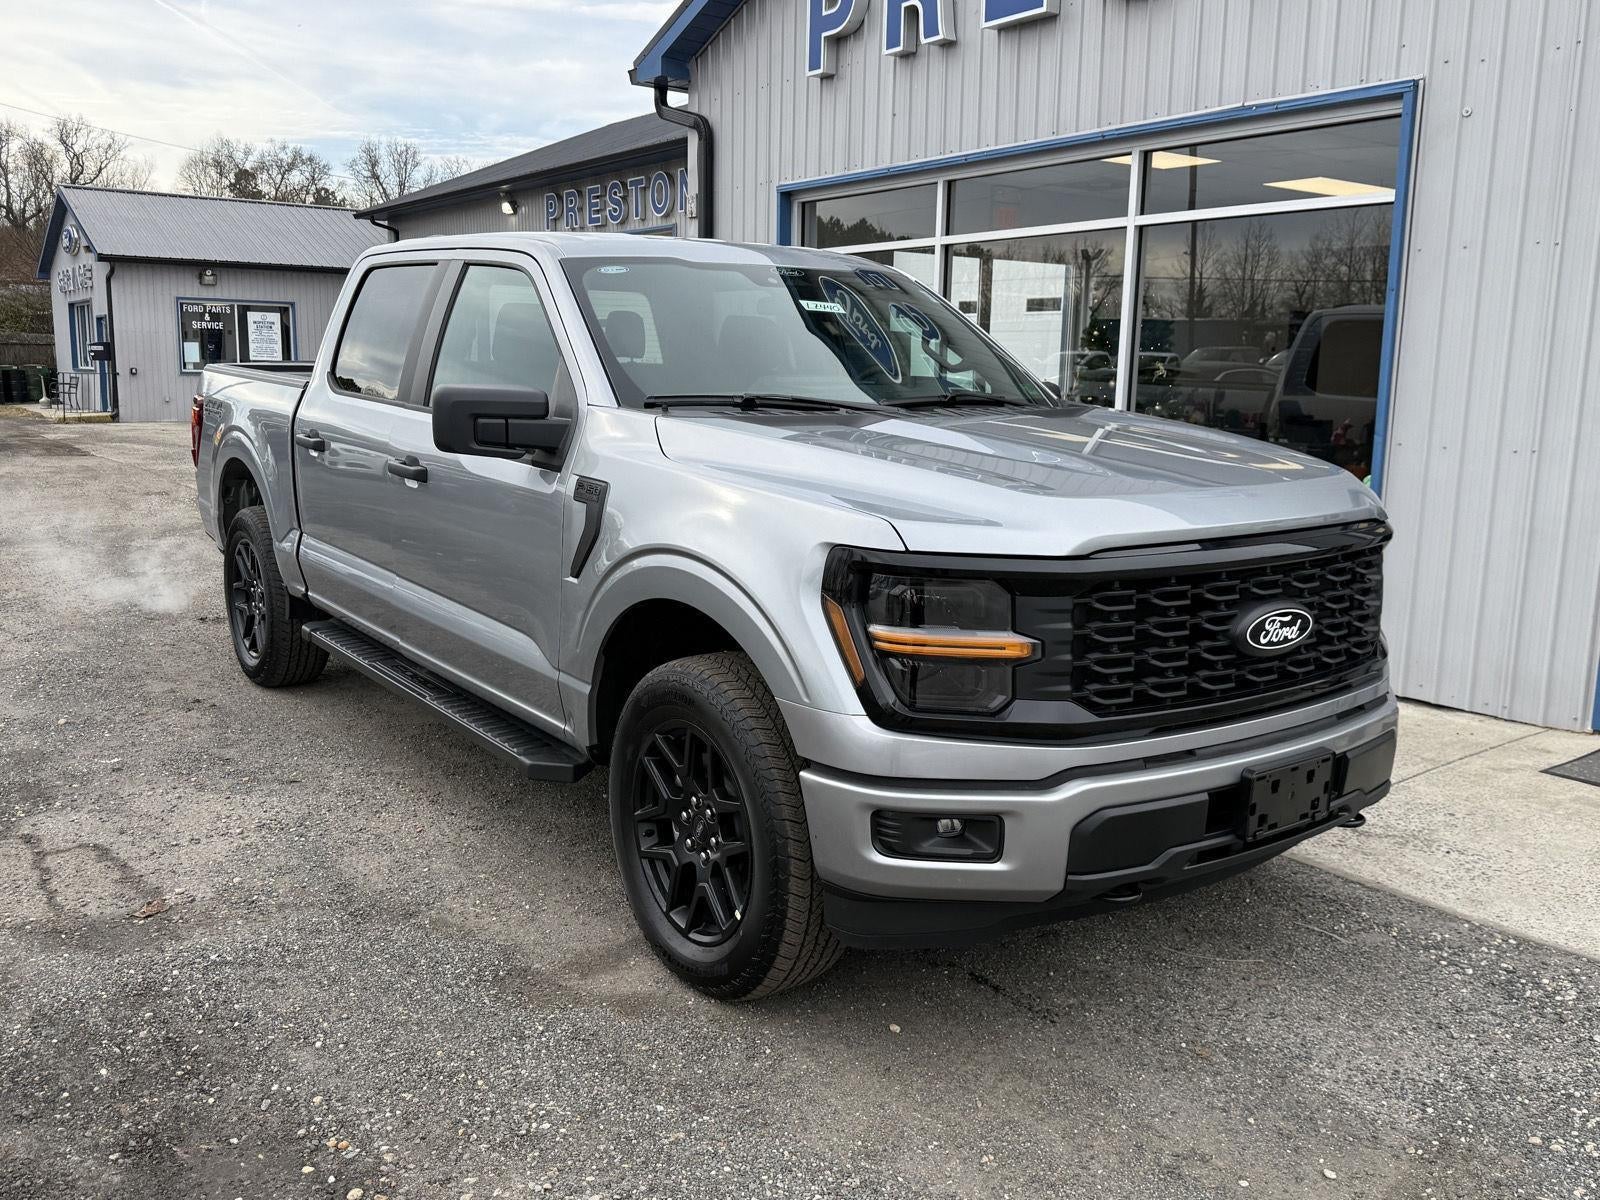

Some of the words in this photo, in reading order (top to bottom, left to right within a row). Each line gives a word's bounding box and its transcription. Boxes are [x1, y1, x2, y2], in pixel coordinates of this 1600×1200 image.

[182, 304, 204, 313] FORD
[206, 304, 231, 314] PARTS
[204, 313, 211, 321] &
[191, 320, 224, 330] SERVICE
[1259, 614, 1302, 644] Ford
